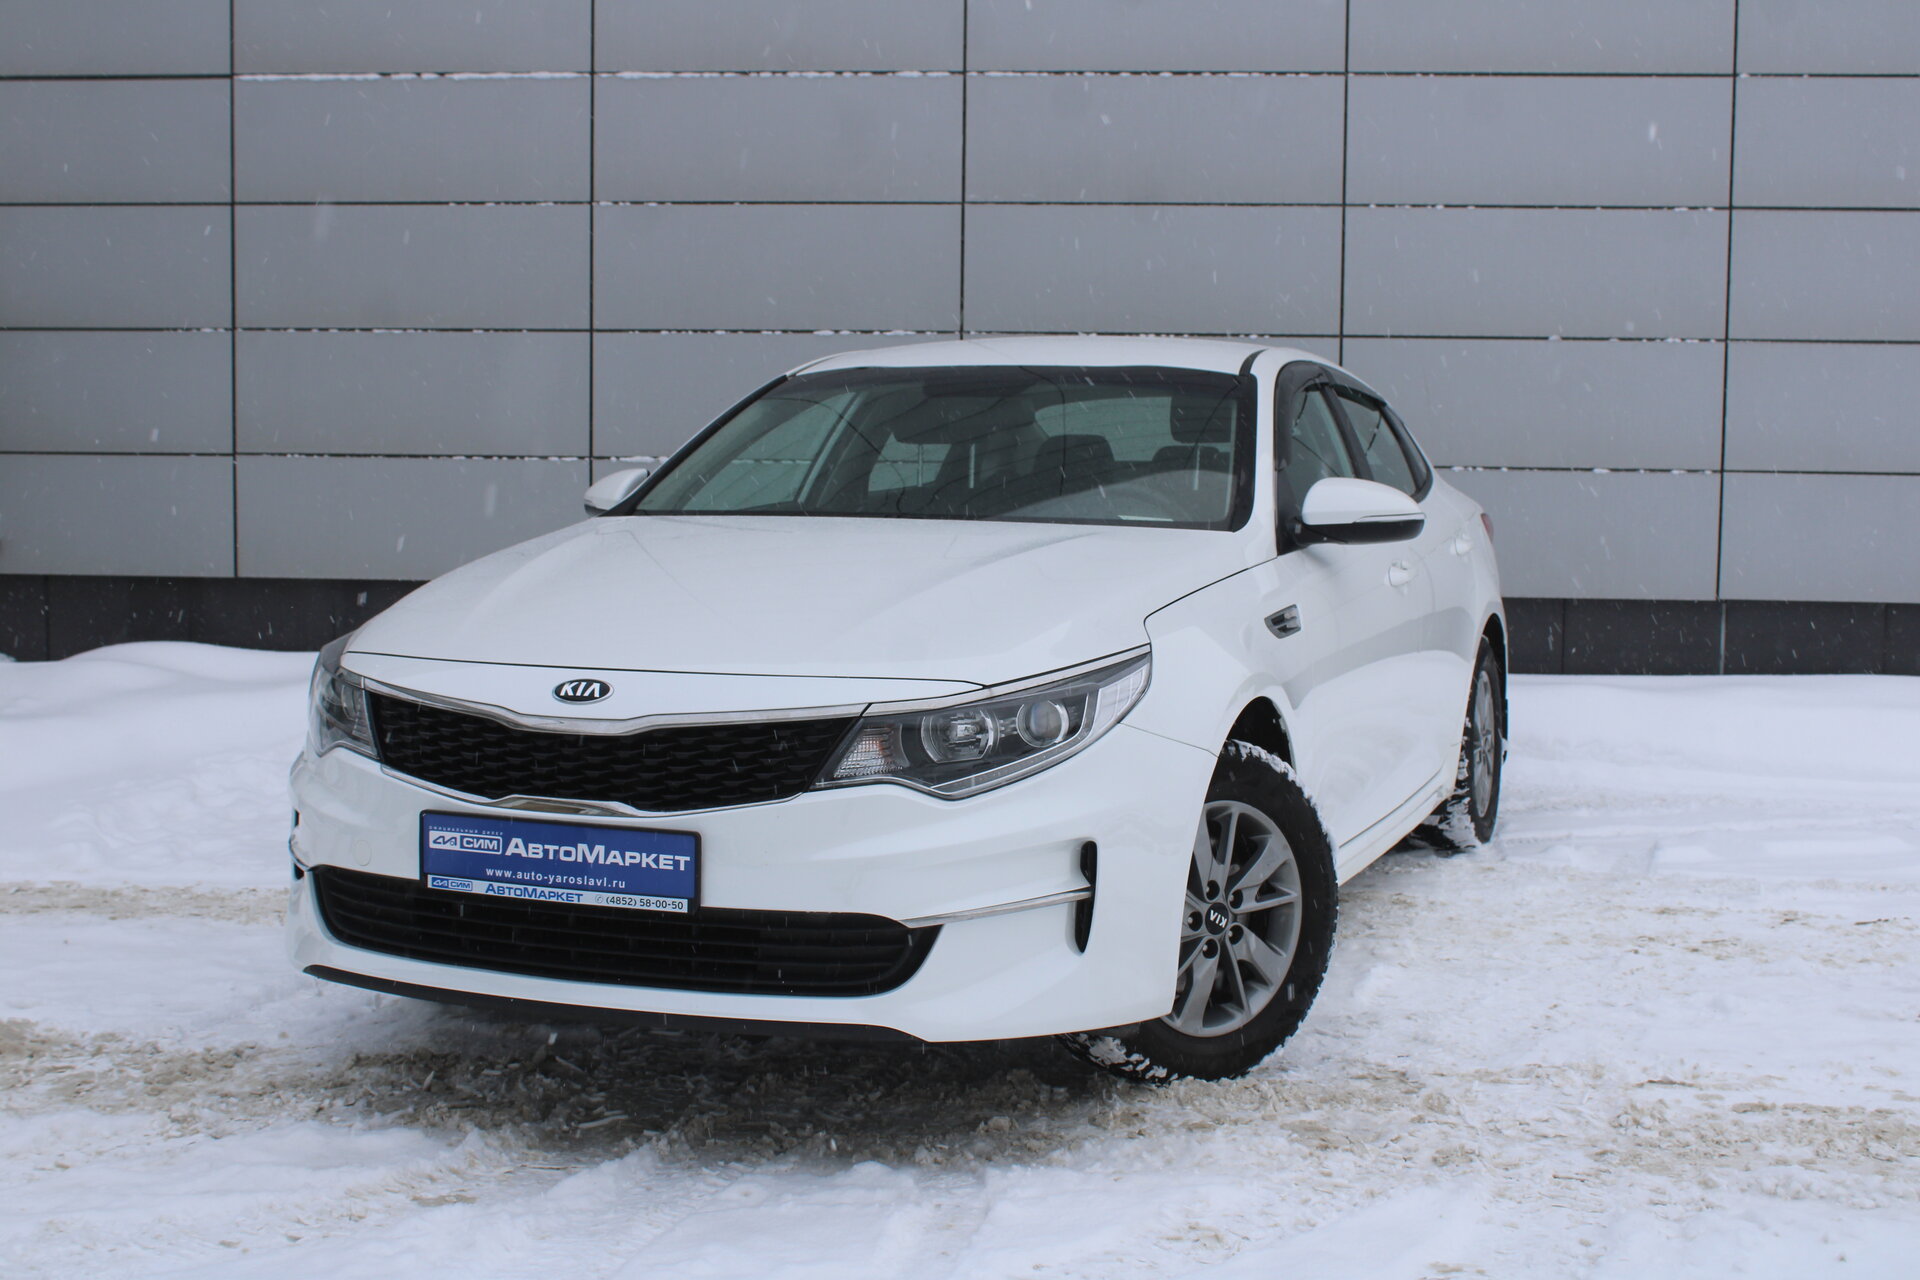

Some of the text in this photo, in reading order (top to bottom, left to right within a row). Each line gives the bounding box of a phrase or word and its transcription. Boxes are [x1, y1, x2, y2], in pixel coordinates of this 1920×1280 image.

[560, 681, 601, 698] KIA
[486, 868, 626, 888] www.auto-yaroslavl.ru
[606, 896, 684, 910] (4852) 58-00-50
